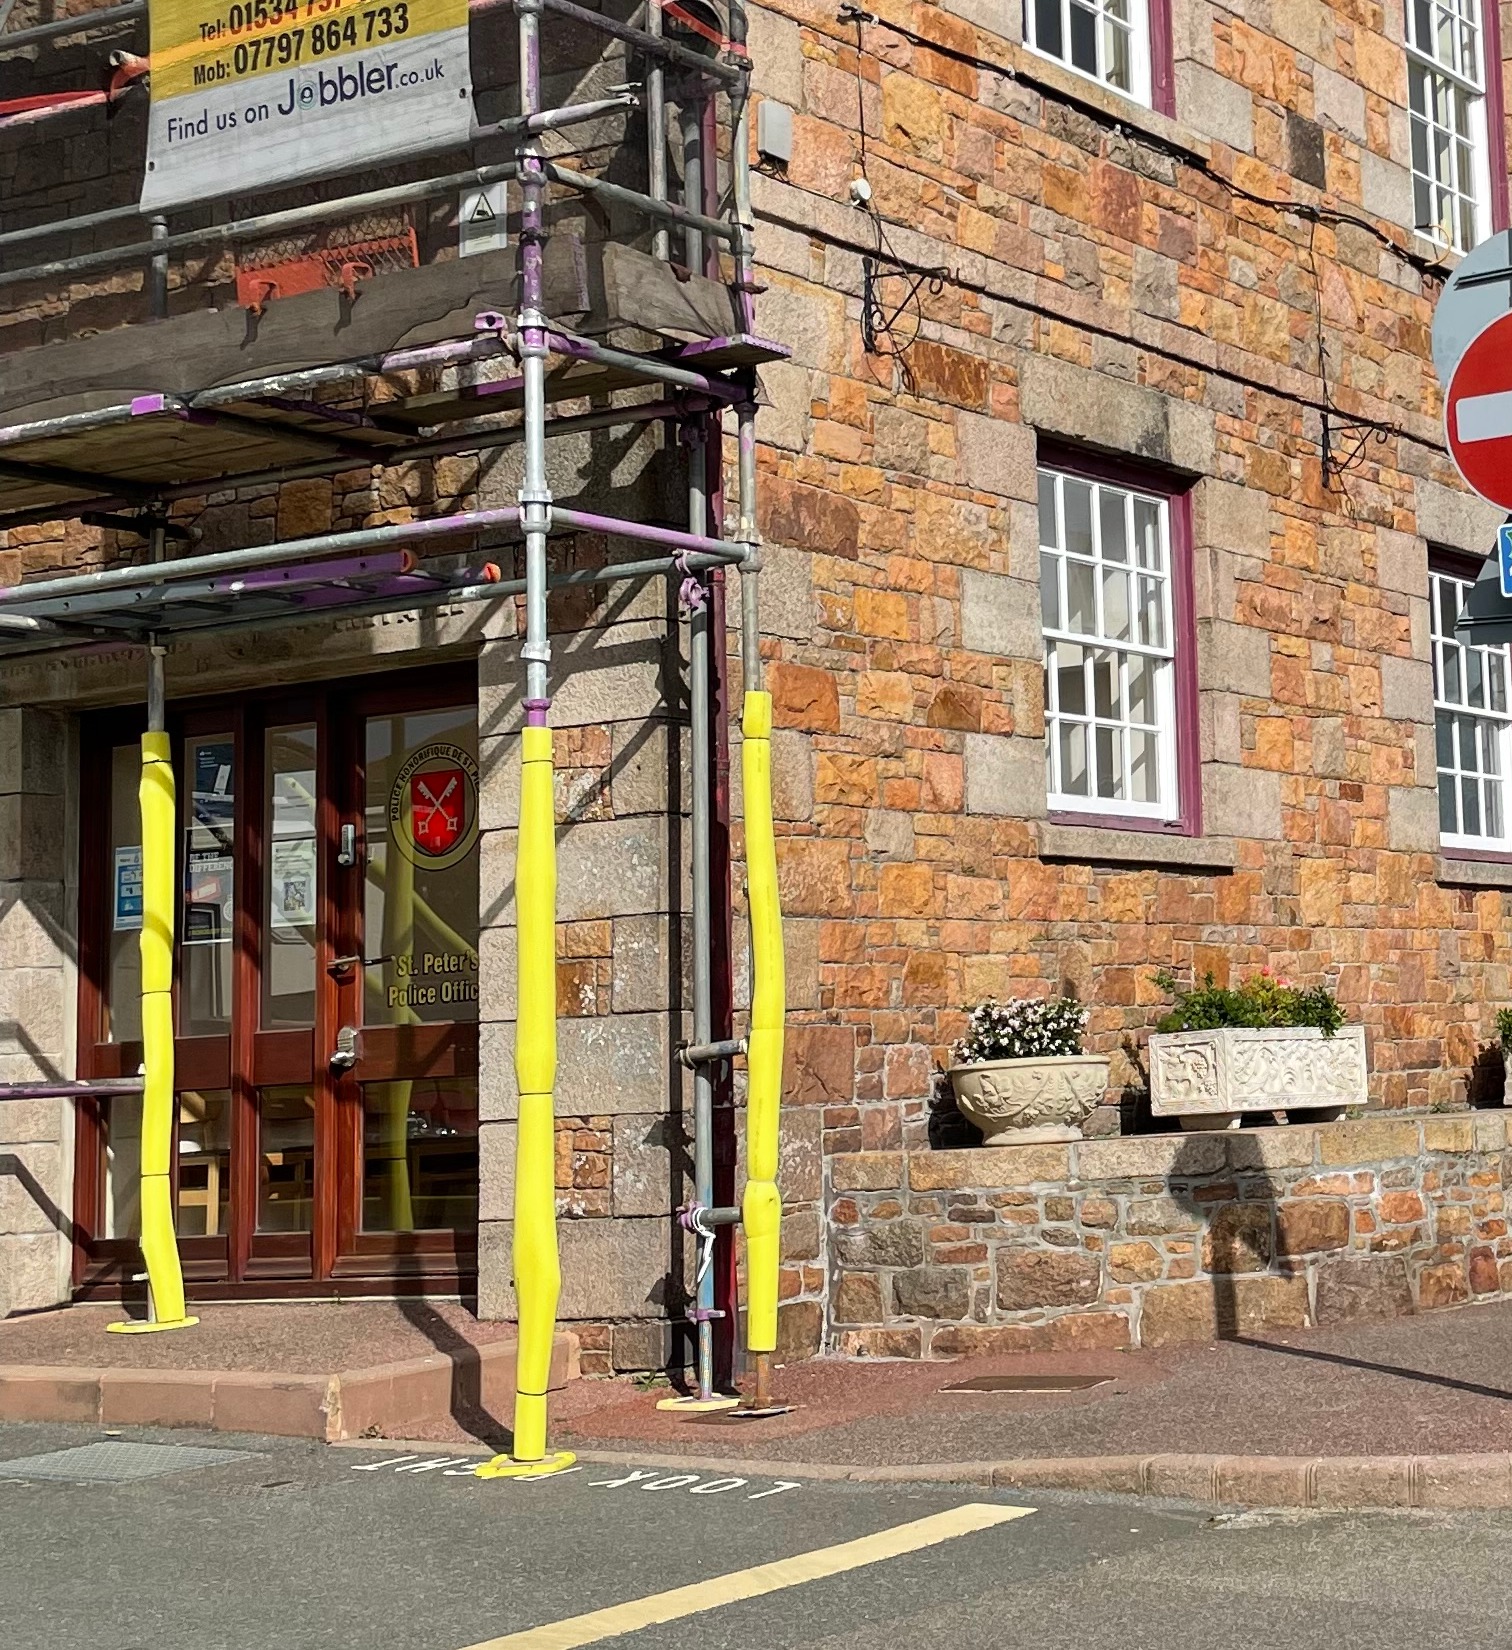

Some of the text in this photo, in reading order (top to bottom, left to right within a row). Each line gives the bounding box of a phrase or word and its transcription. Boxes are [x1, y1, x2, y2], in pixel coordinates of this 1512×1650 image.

[200, 19, 226, 42] Tel:
[229, 0, 298, 35] 01534
[193, 61, 230, 86] Mob:
[234, 29, 305, 74] 07797
[311, 15, 357, 55] 864
[363, 3, 409, 44] 733
[167, 109, 209, 142] Find
[216, 110, 237, 130] us
[245, 103, 269, 123] on
[391, 782, 403, 821] POLICE
[399, 745, 451, 781] HONORIFIQUE
[451, 748, 464, 761] DE
[397, 949, 479, 977] St. Peter's
[388, 980, 479, 1008] Police Offic
[350, 1454, 802, 1499] LOOK RGHT
